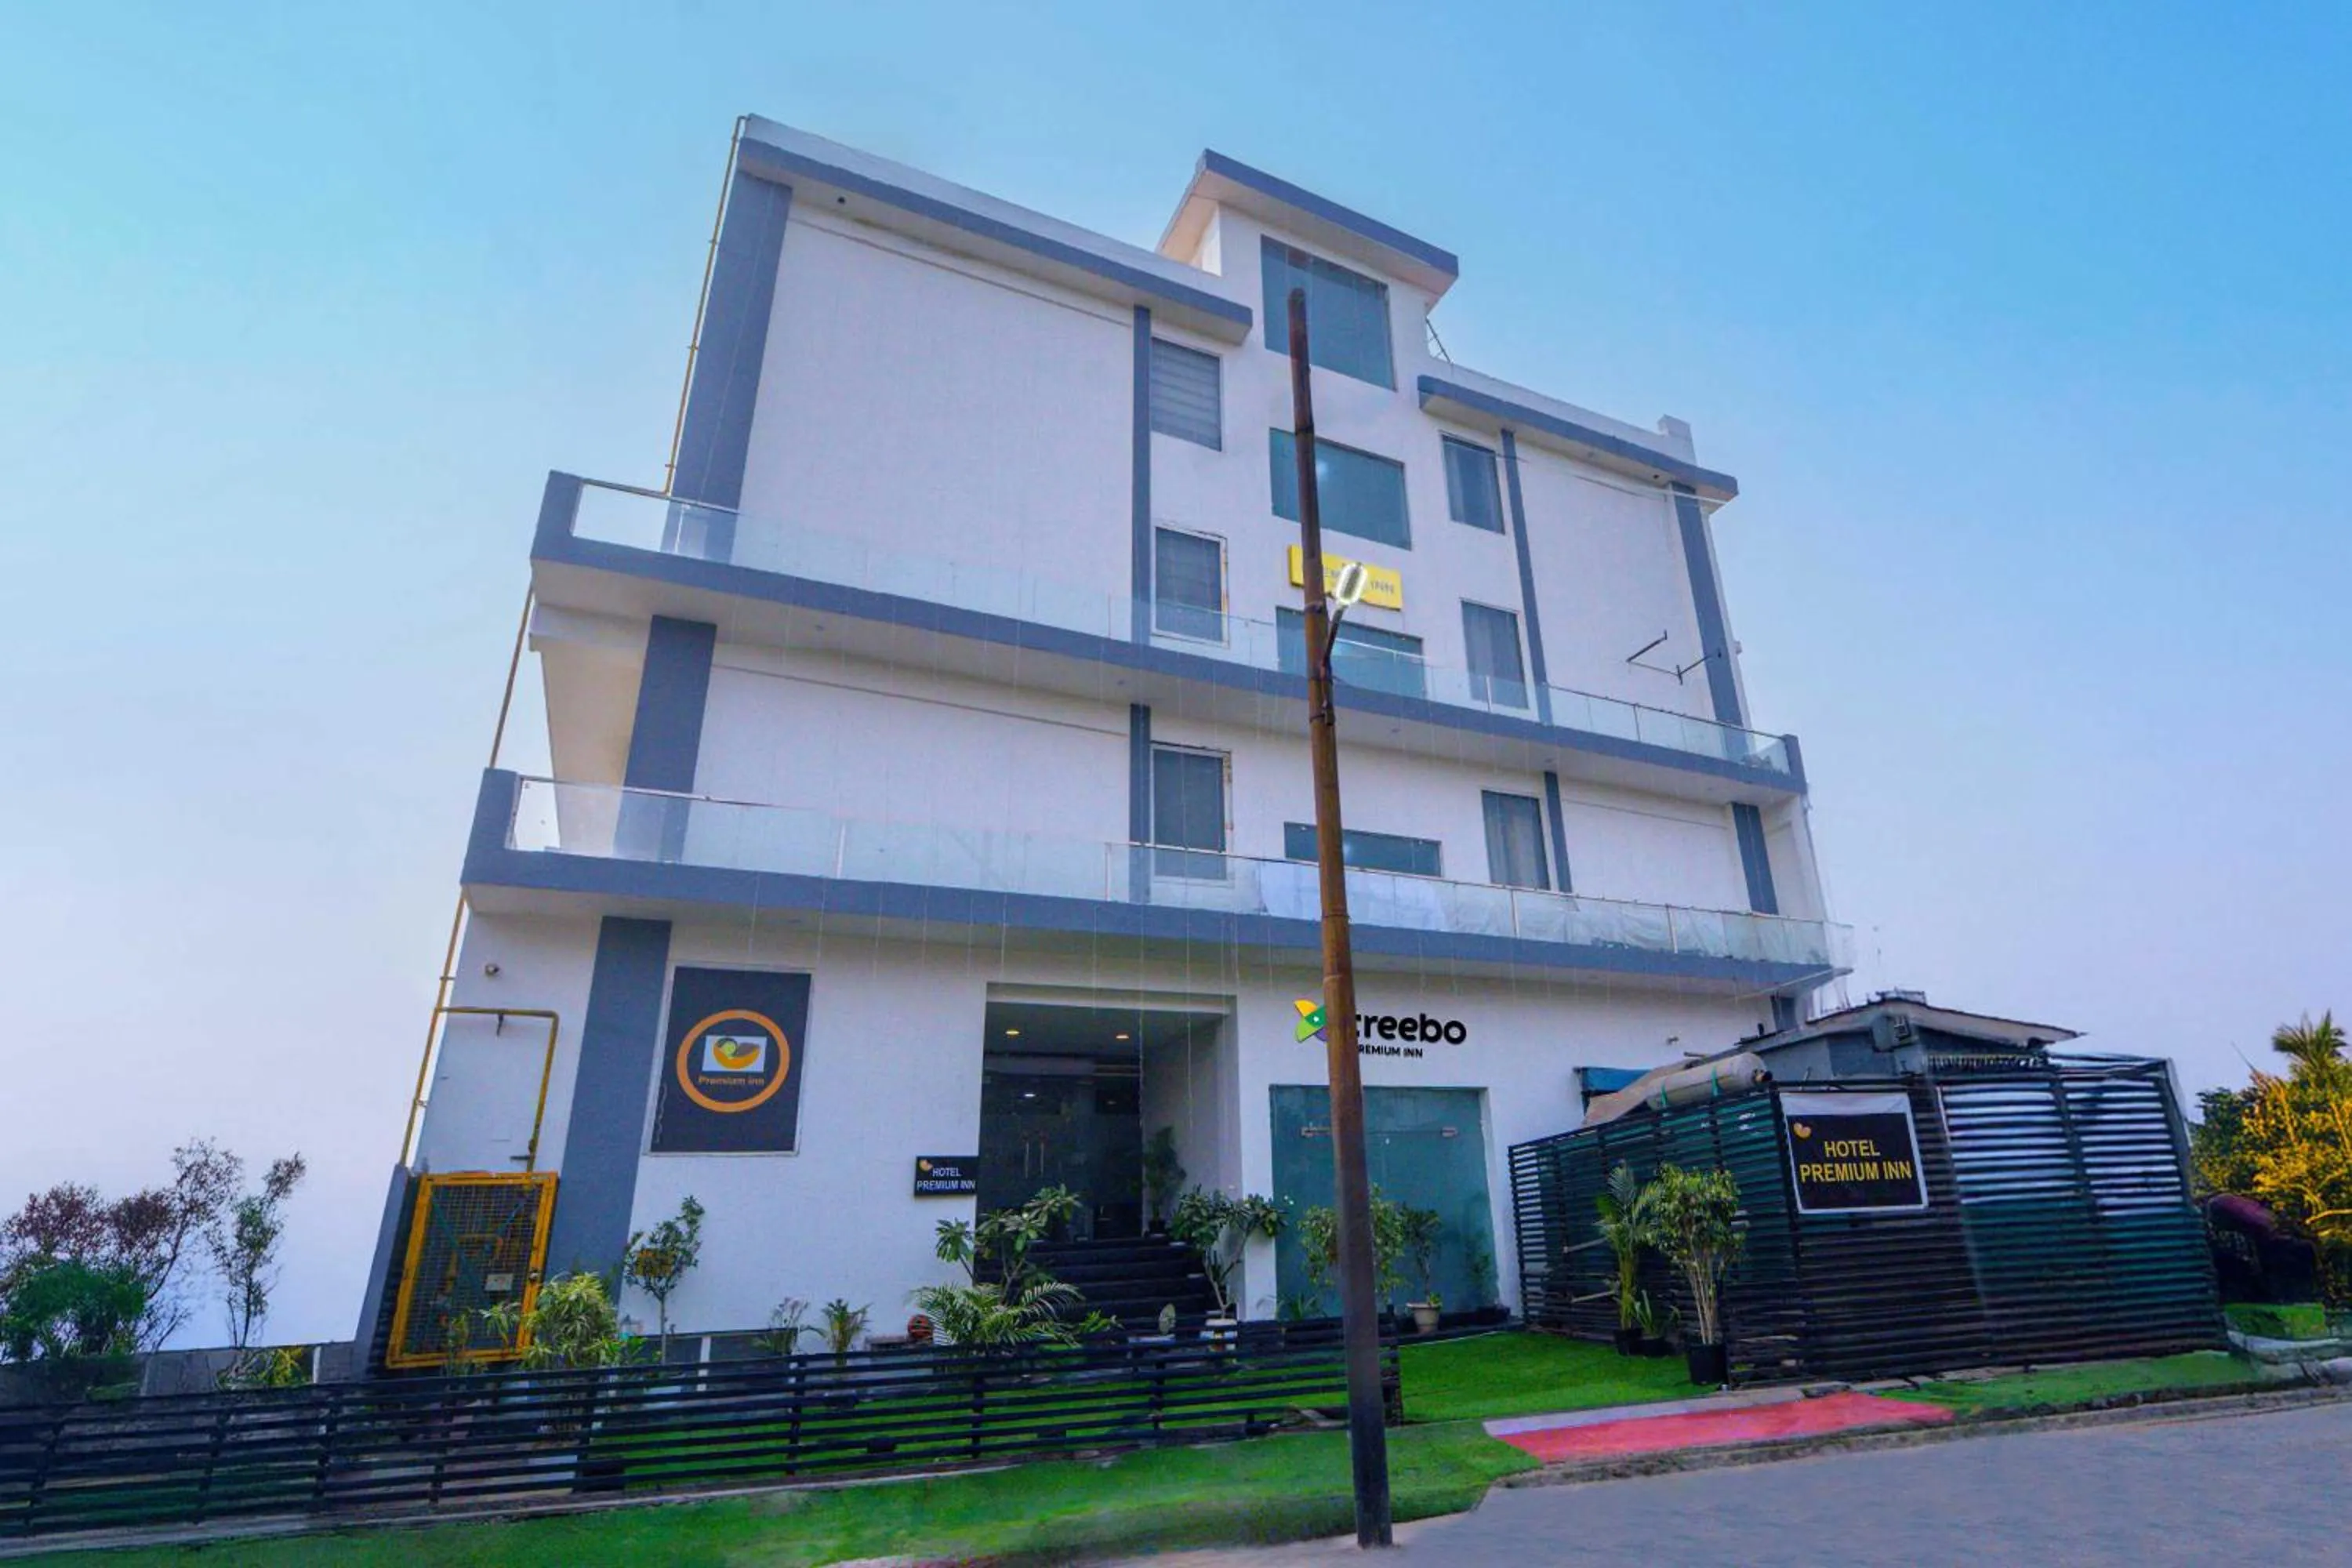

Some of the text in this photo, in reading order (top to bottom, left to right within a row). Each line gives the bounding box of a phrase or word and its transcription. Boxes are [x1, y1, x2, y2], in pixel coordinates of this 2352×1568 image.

[1357, 1044, 1423, 1058] REMIUM INN
[1824, 1140, 1881, 1158] HOTEL
[932, 1167, 962, 1177] HOTEL
[1799, 1160, 1912, 1183] PREMIUM INN
[916, 1179, 976, 1191] PREMIUM INN
